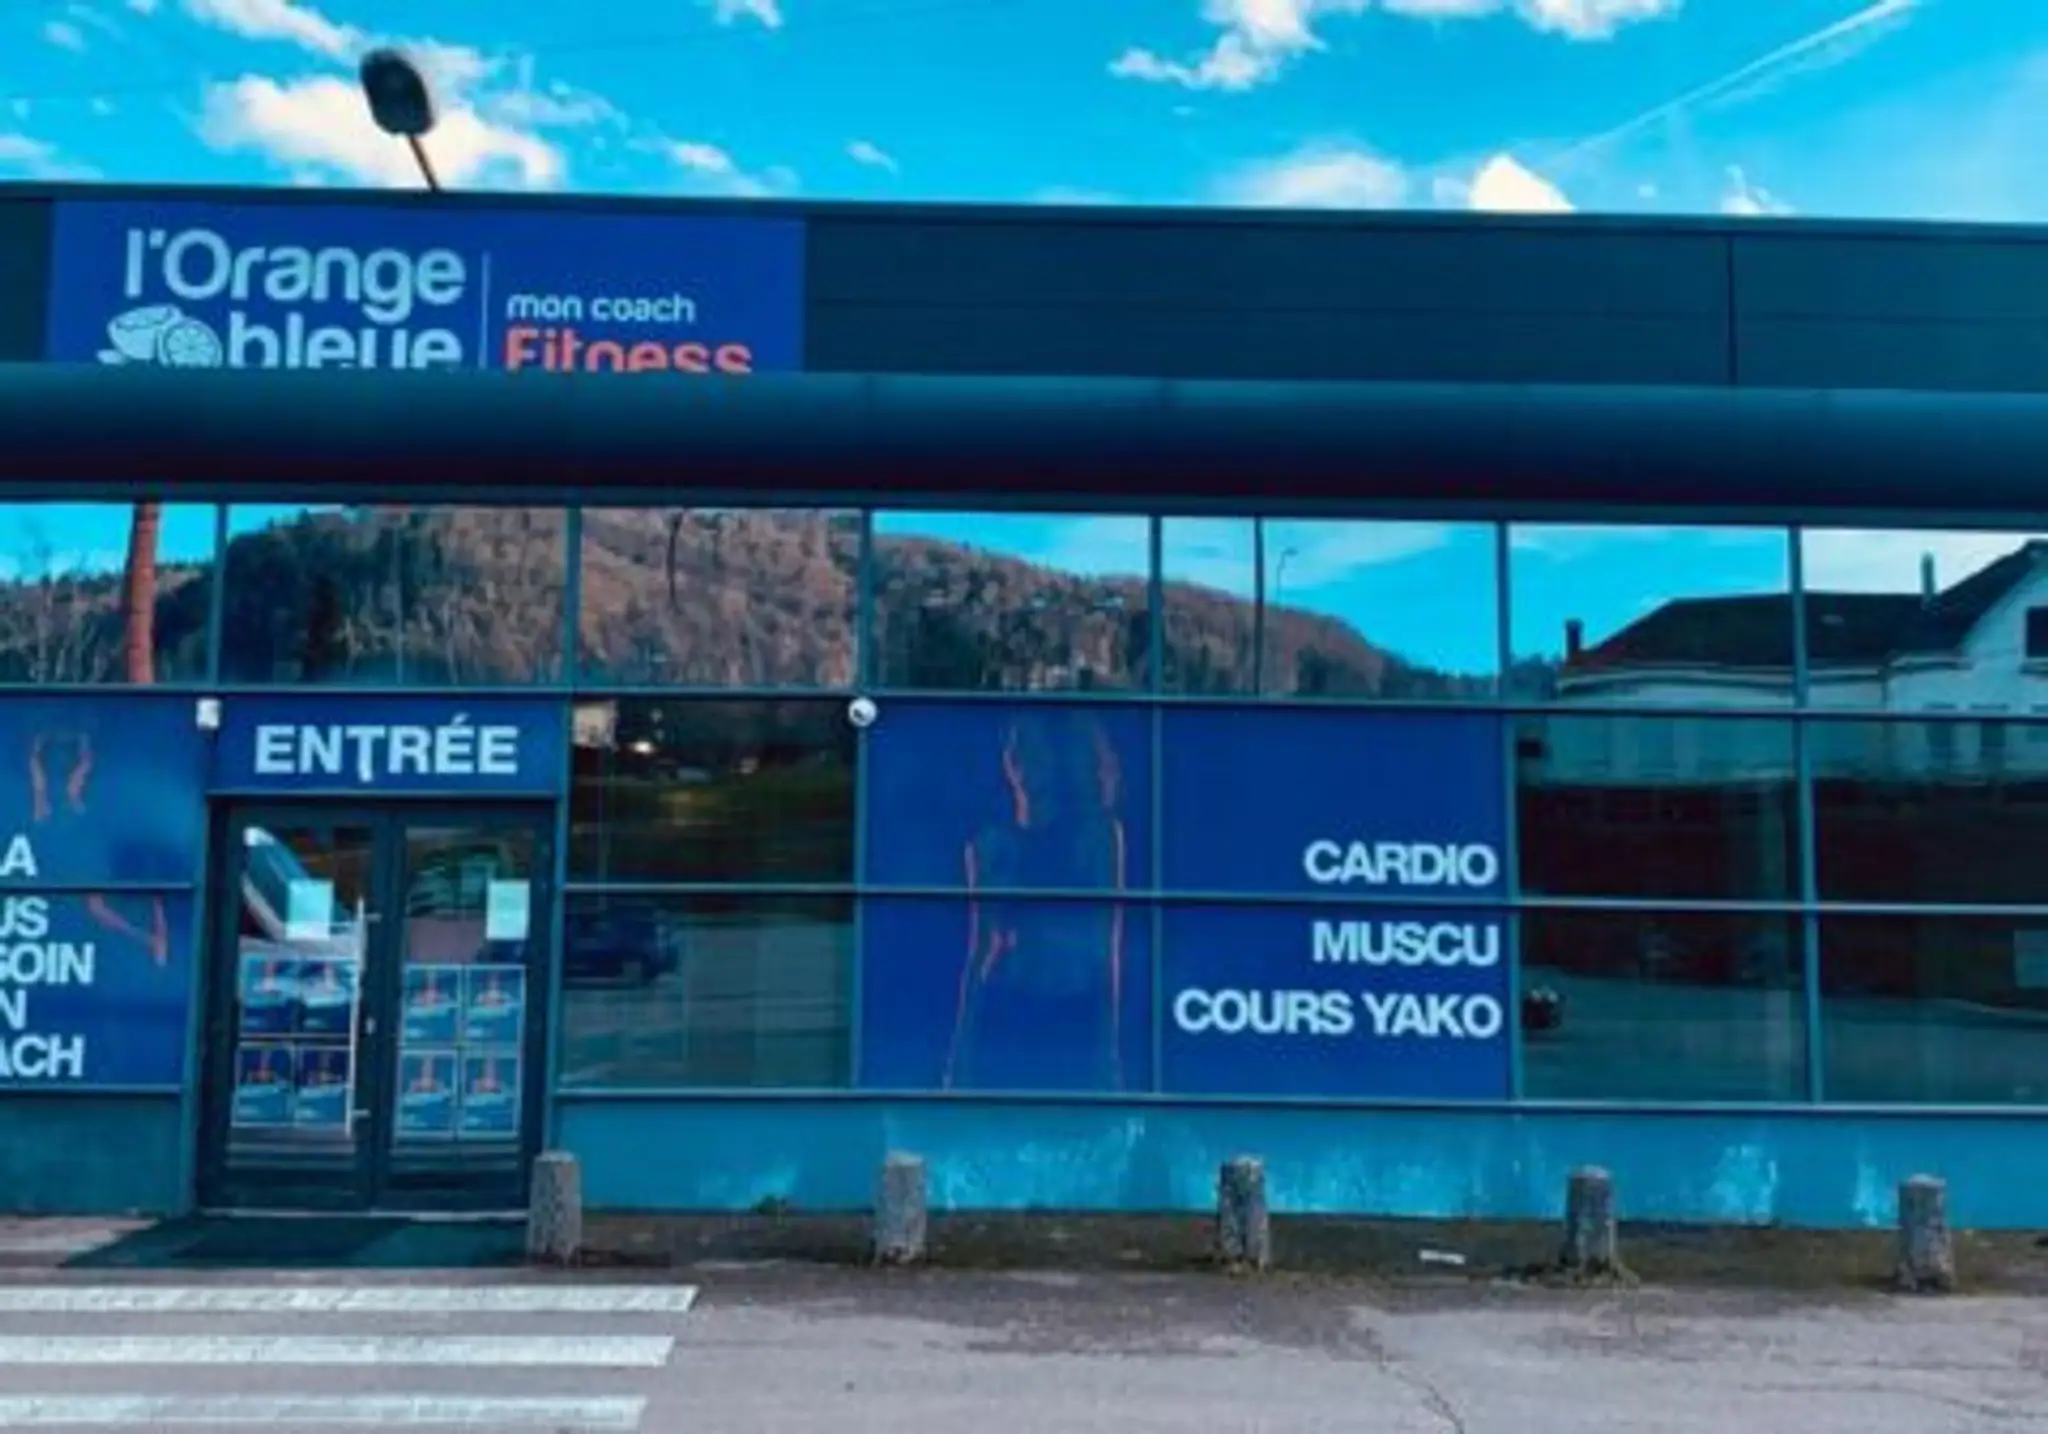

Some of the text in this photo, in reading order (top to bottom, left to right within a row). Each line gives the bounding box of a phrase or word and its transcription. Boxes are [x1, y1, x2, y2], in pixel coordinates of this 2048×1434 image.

[125, 229, 466, 325] l'Orange
[506, 292, 696, 322] mon coach
[254, 714, 519, 782] ENTRÉE
[1303, 840, 1498, 887] CARDIO
[1312, 920, 1499, 967] MUSCU
[1174, 989, 1503, 1038] COURS YAKO
